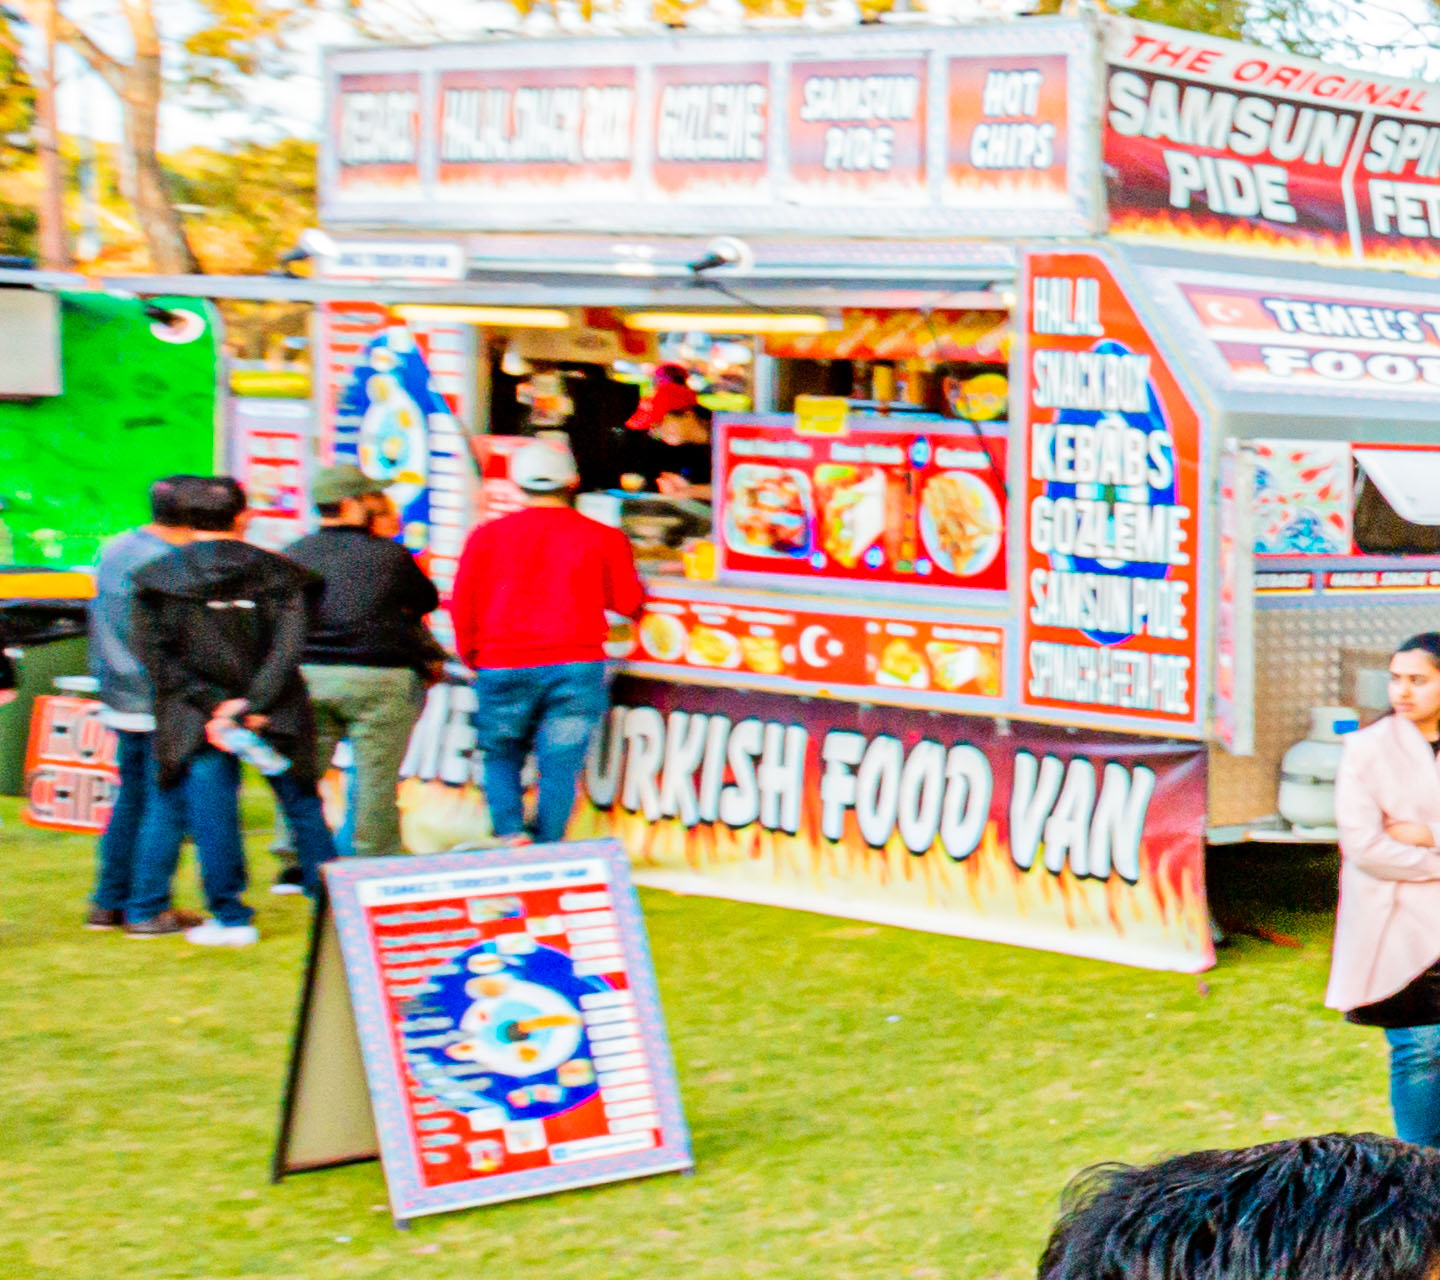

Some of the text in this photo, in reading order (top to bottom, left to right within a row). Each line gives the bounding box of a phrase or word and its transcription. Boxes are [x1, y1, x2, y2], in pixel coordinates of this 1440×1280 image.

[983, 68, 1043, 117] HOT
[1125, 34, 1212, 76] THE
[1231, 57, 1430, 115] ORIGINAL
[824, 124, 897, 171] PIDE
[970, 122, 1057, 169] CHIPS
[1107, 71, 1355, 168] SAMSUN
[1163, 149, 1297, 224] PIDE
[1032, 276, 1104, 338] HALAL
[1263, 298, 1425, 345] TEMEL'S
[1031, 422, 1174, 490] KEBABS
[1030, 495, 1191, 565] GOZLEME
[586, 704, 808, 836] URKISH
[821, 728, 994, 860] FOOD
[1009, 748, 1156, 886] VAN
